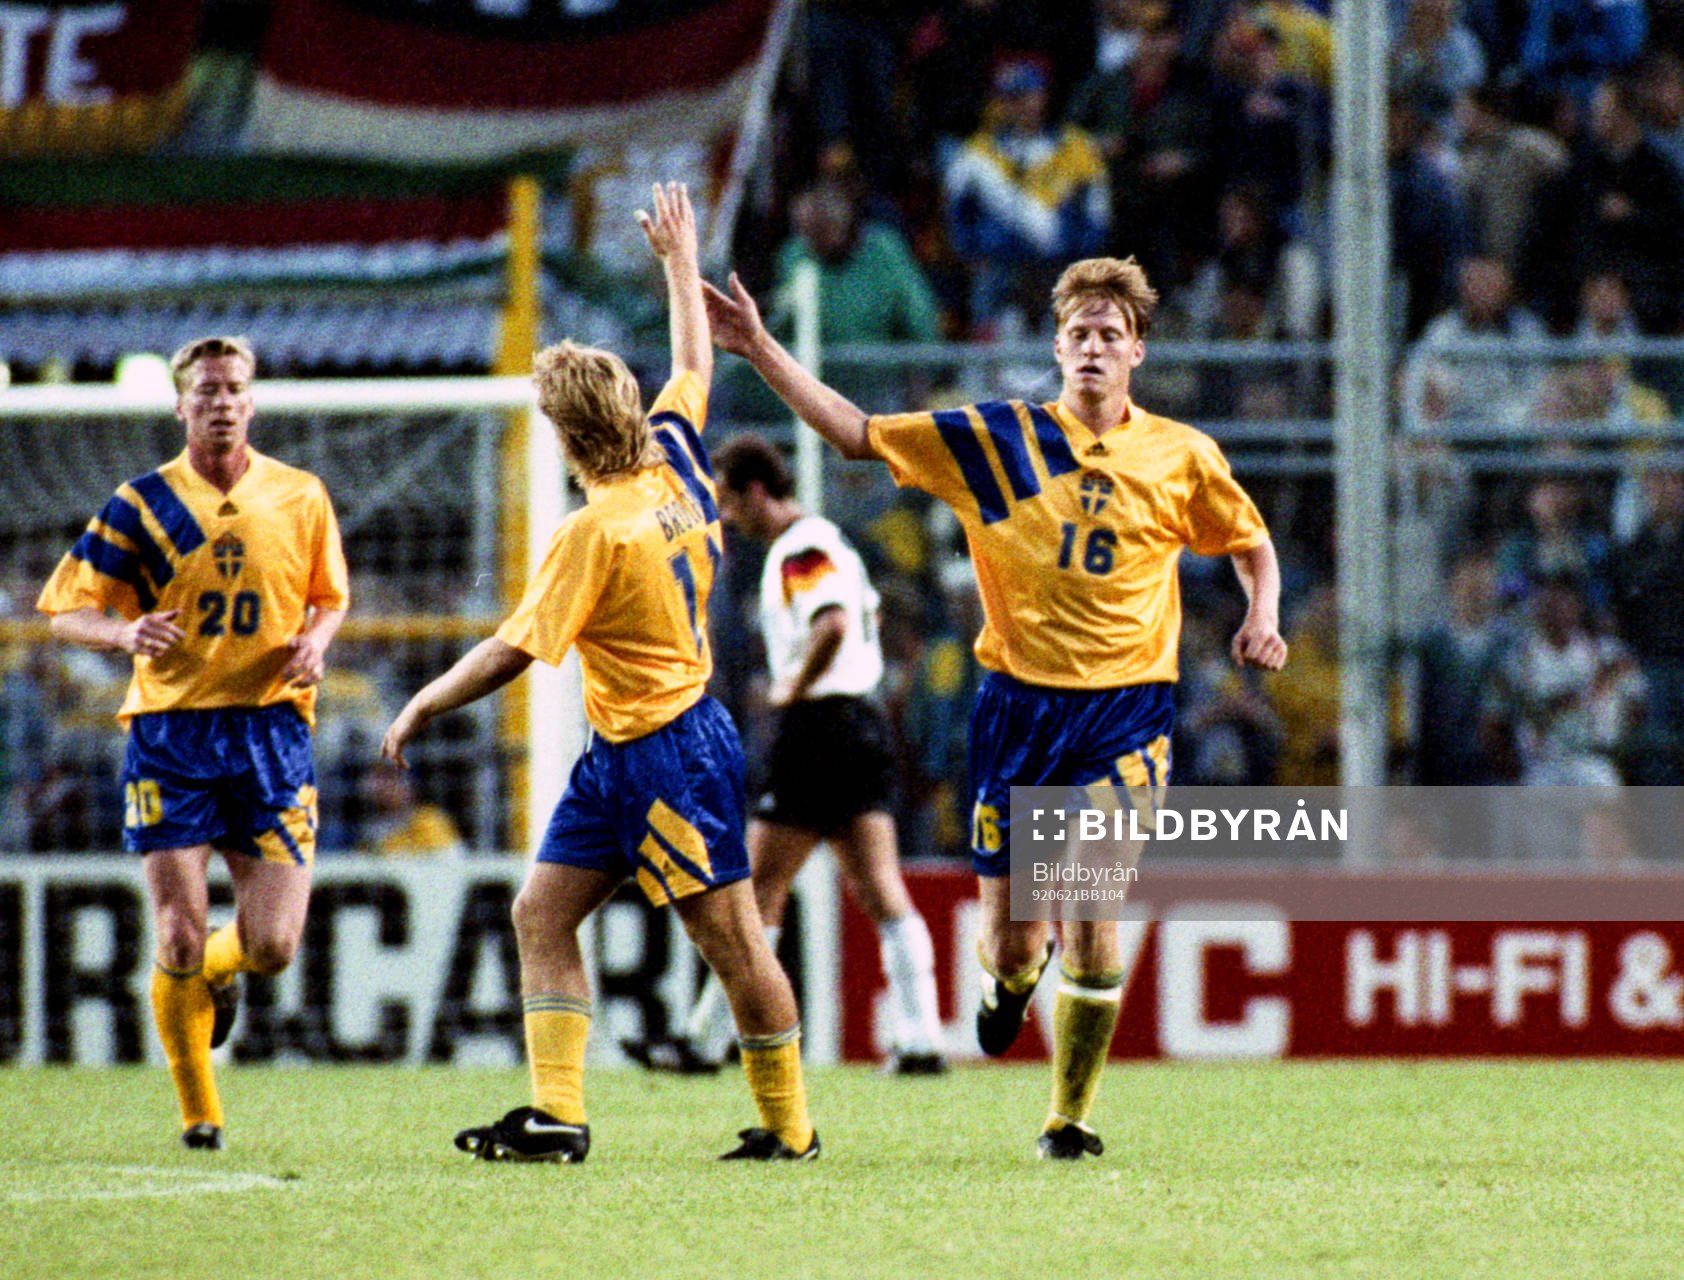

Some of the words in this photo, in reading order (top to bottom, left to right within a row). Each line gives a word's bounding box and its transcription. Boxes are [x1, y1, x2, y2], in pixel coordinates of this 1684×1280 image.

[1057, 521, 1119, 577] 16
[197, 589, 262, 637] 20
[1345, 929, 1590, 1026] HI-FI
